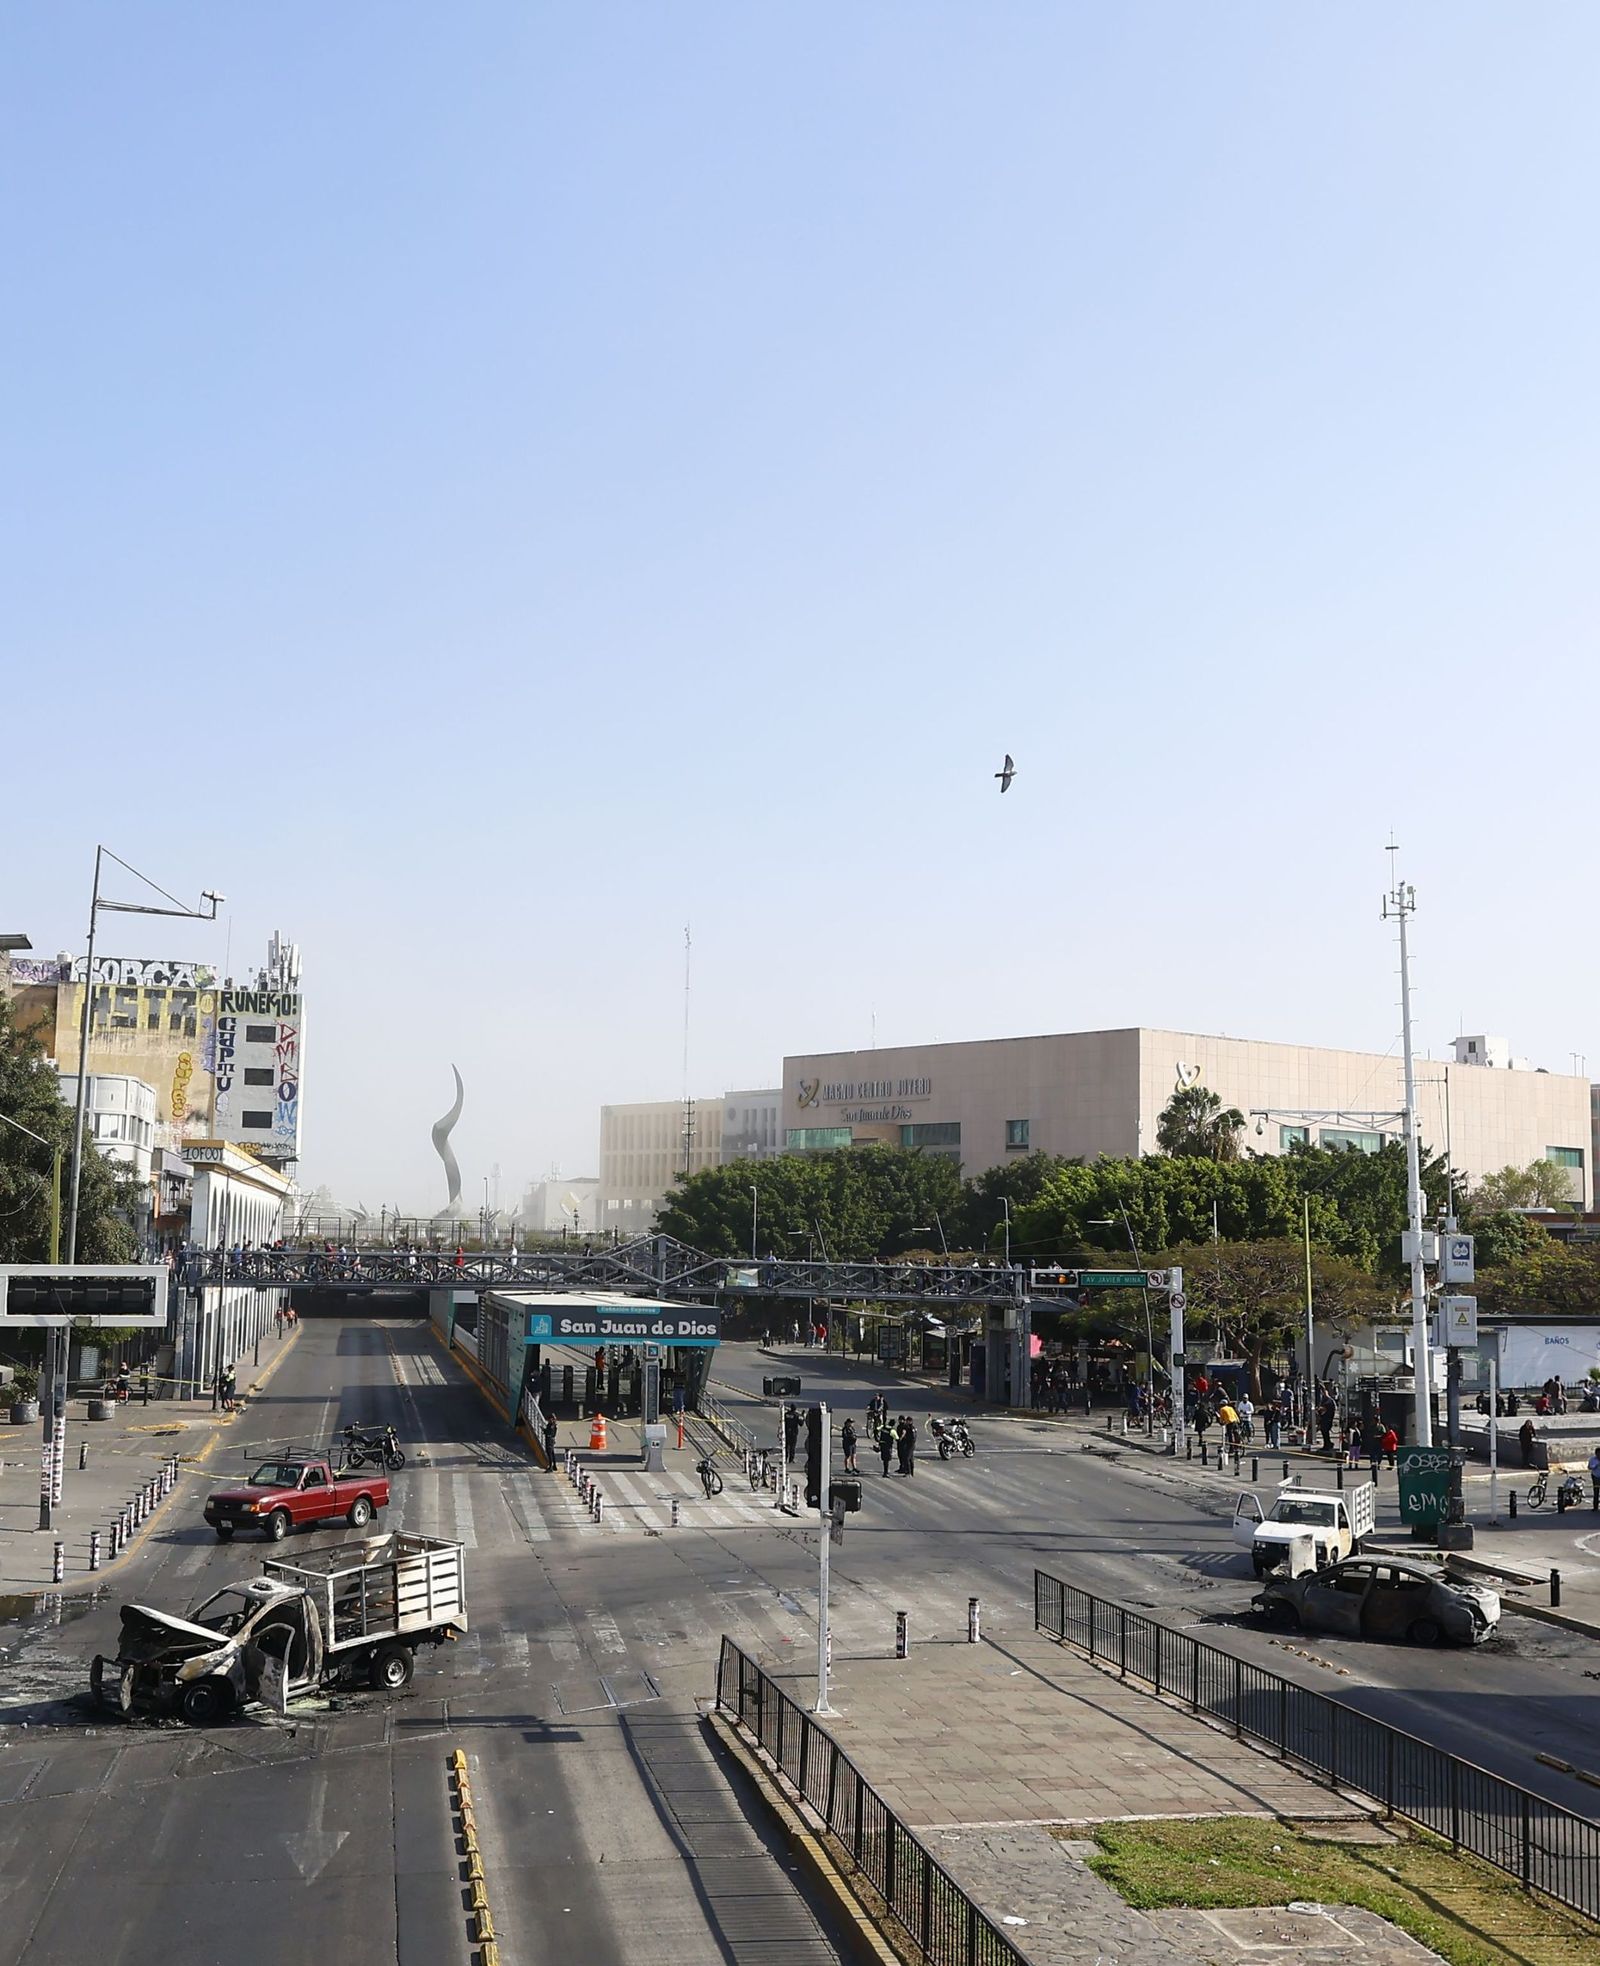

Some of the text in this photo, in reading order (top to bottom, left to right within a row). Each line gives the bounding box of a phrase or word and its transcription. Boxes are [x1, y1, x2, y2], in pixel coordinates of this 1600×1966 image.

[823, 1077, 931, 1100] MAGNO CENTRO JOYERO
[891, 1105, 912, 1120] Dios
[1098, 1276, 1121, 1284] JAVIER
[1124, 1276, 1142, 1284] MINA
[560, 1318, 717, 1336] San Juan de Dios
[1545, 1336, 1570, 1345] BAÑOS
